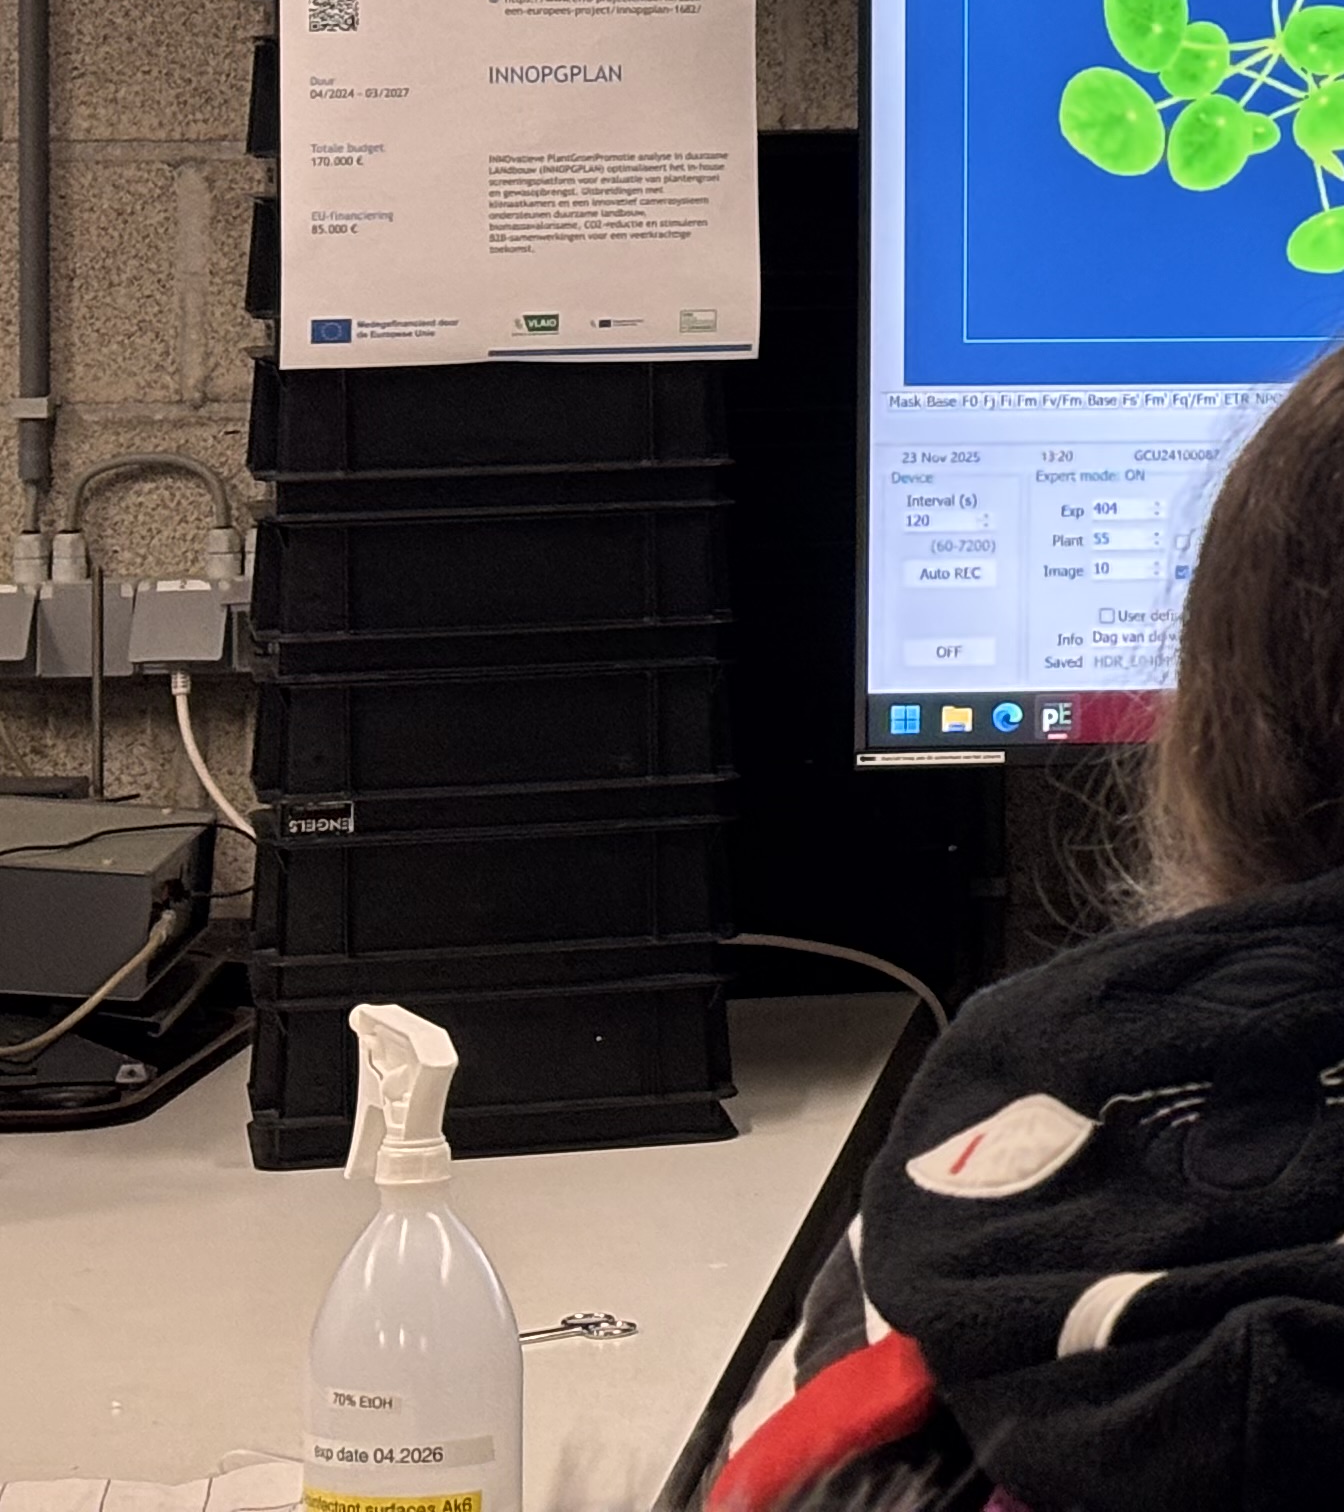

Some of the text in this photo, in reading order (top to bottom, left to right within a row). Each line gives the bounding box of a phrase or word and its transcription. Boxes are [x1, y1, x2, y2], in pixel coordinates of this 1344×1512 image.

[489, 65, 622, 84] INNOPGPLAN
[310, 76, 335, 87] Duur
[310, 88, 354, 100] 04/2024
[365, 87, 409, 99] 03/2027
[311, 143, 385, 156] Totale budget
[311, 156, 353, 167] 170.000
[311, 210, 393, 224] EU-financiering
[311, 224, 348, 235] 85.000
[527, 318, 557, 329] VLAIO
[889, 395, 922, 408] Mask
[927, 395, 957, 408] Base
[962, 395, 978, 407] F0
[1017, 395, 1038, 407] Fm
[1042, 395, 1082, 408] Fv/Fm
[1088, 394, 1117, 407] Base
[1224, 393, 1249, 405] ETR
[902, 452, 980, 463] 23 Nov 2025
[891, 472, 934, 484] Device
[907, 495, 978, 509] Interval (s)
[1061, 503, 1117, 519] Exp 404
[906, 514, 930, 526] 120
[931, 539, 996, 554] (60-7200)
[1052, 533, 1109, 547] Plant 55
[919, 567, 981, 580] Auto REC
[1057, 634, 1083, 646] Info
[1093, 630, 1144, 645] Dag van
[936, 646, 963, 658] OFF
[1045, 656, 1083, 668] Saved
[288, 818, 354, 833] ENGELS
[332, 1392, 393, 1410] 70% EtOH
[337, 1446, 369, 1464] date
[373, 1446, 444, 1464] 04.2026
